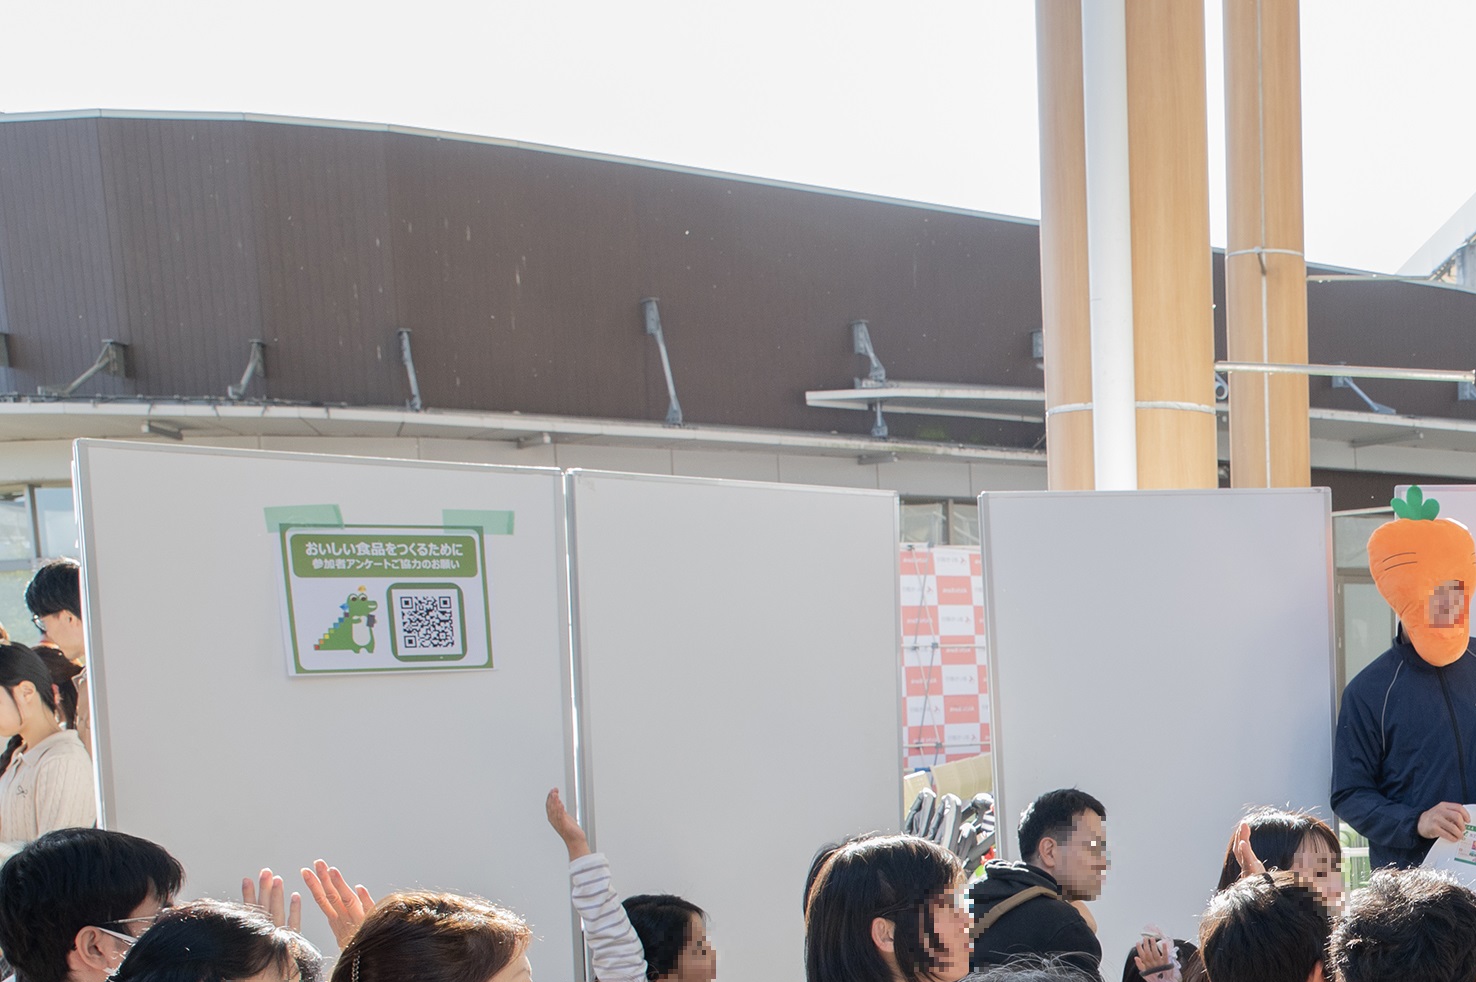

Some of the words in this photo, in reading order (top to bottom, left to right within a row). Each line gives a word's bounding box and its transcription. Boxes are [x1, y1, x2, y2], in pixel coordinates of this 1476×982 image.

[305, 541, 464, 556] おいしい食品をつくるために
[312, 558, 460, 570] 参加者アンケートご協力のお願い
